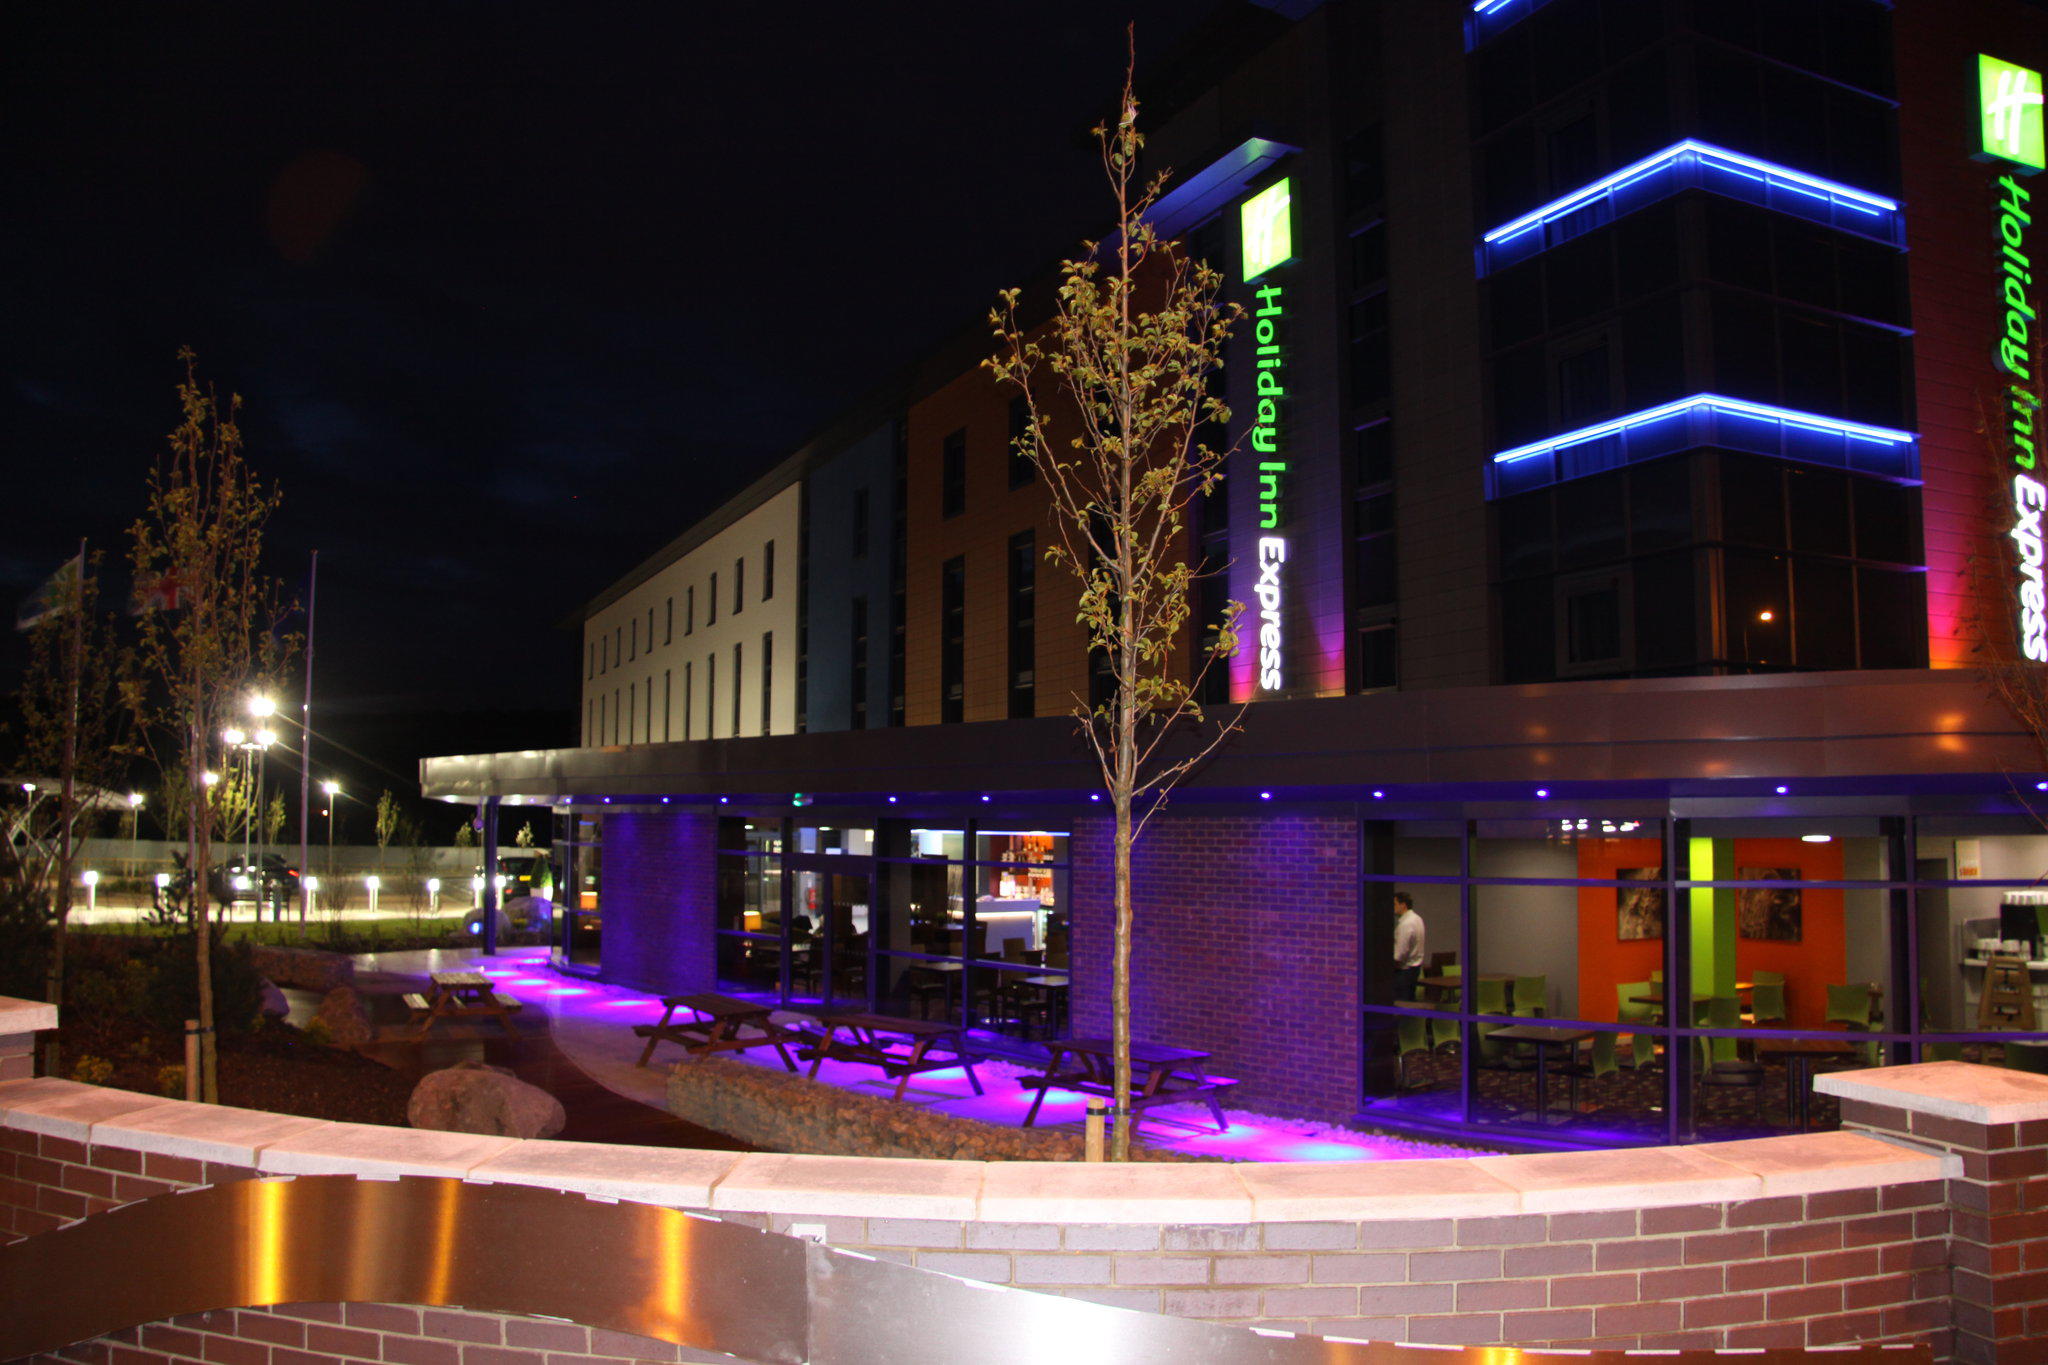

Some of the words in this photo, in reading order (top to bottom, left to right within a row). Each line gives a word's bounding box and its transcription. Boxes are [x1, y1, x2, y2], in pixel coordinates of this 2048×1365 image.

[1999, 175, 2037, 380] Holiday
[1251, 284, 1284, 452] Holiday
[2010, 385, 2042, 470] Inn
[1258, 461, 1287, 529] Inn
[2010, 474, 2048, 663] Express
[1253, 536, 1287, 691] Express
